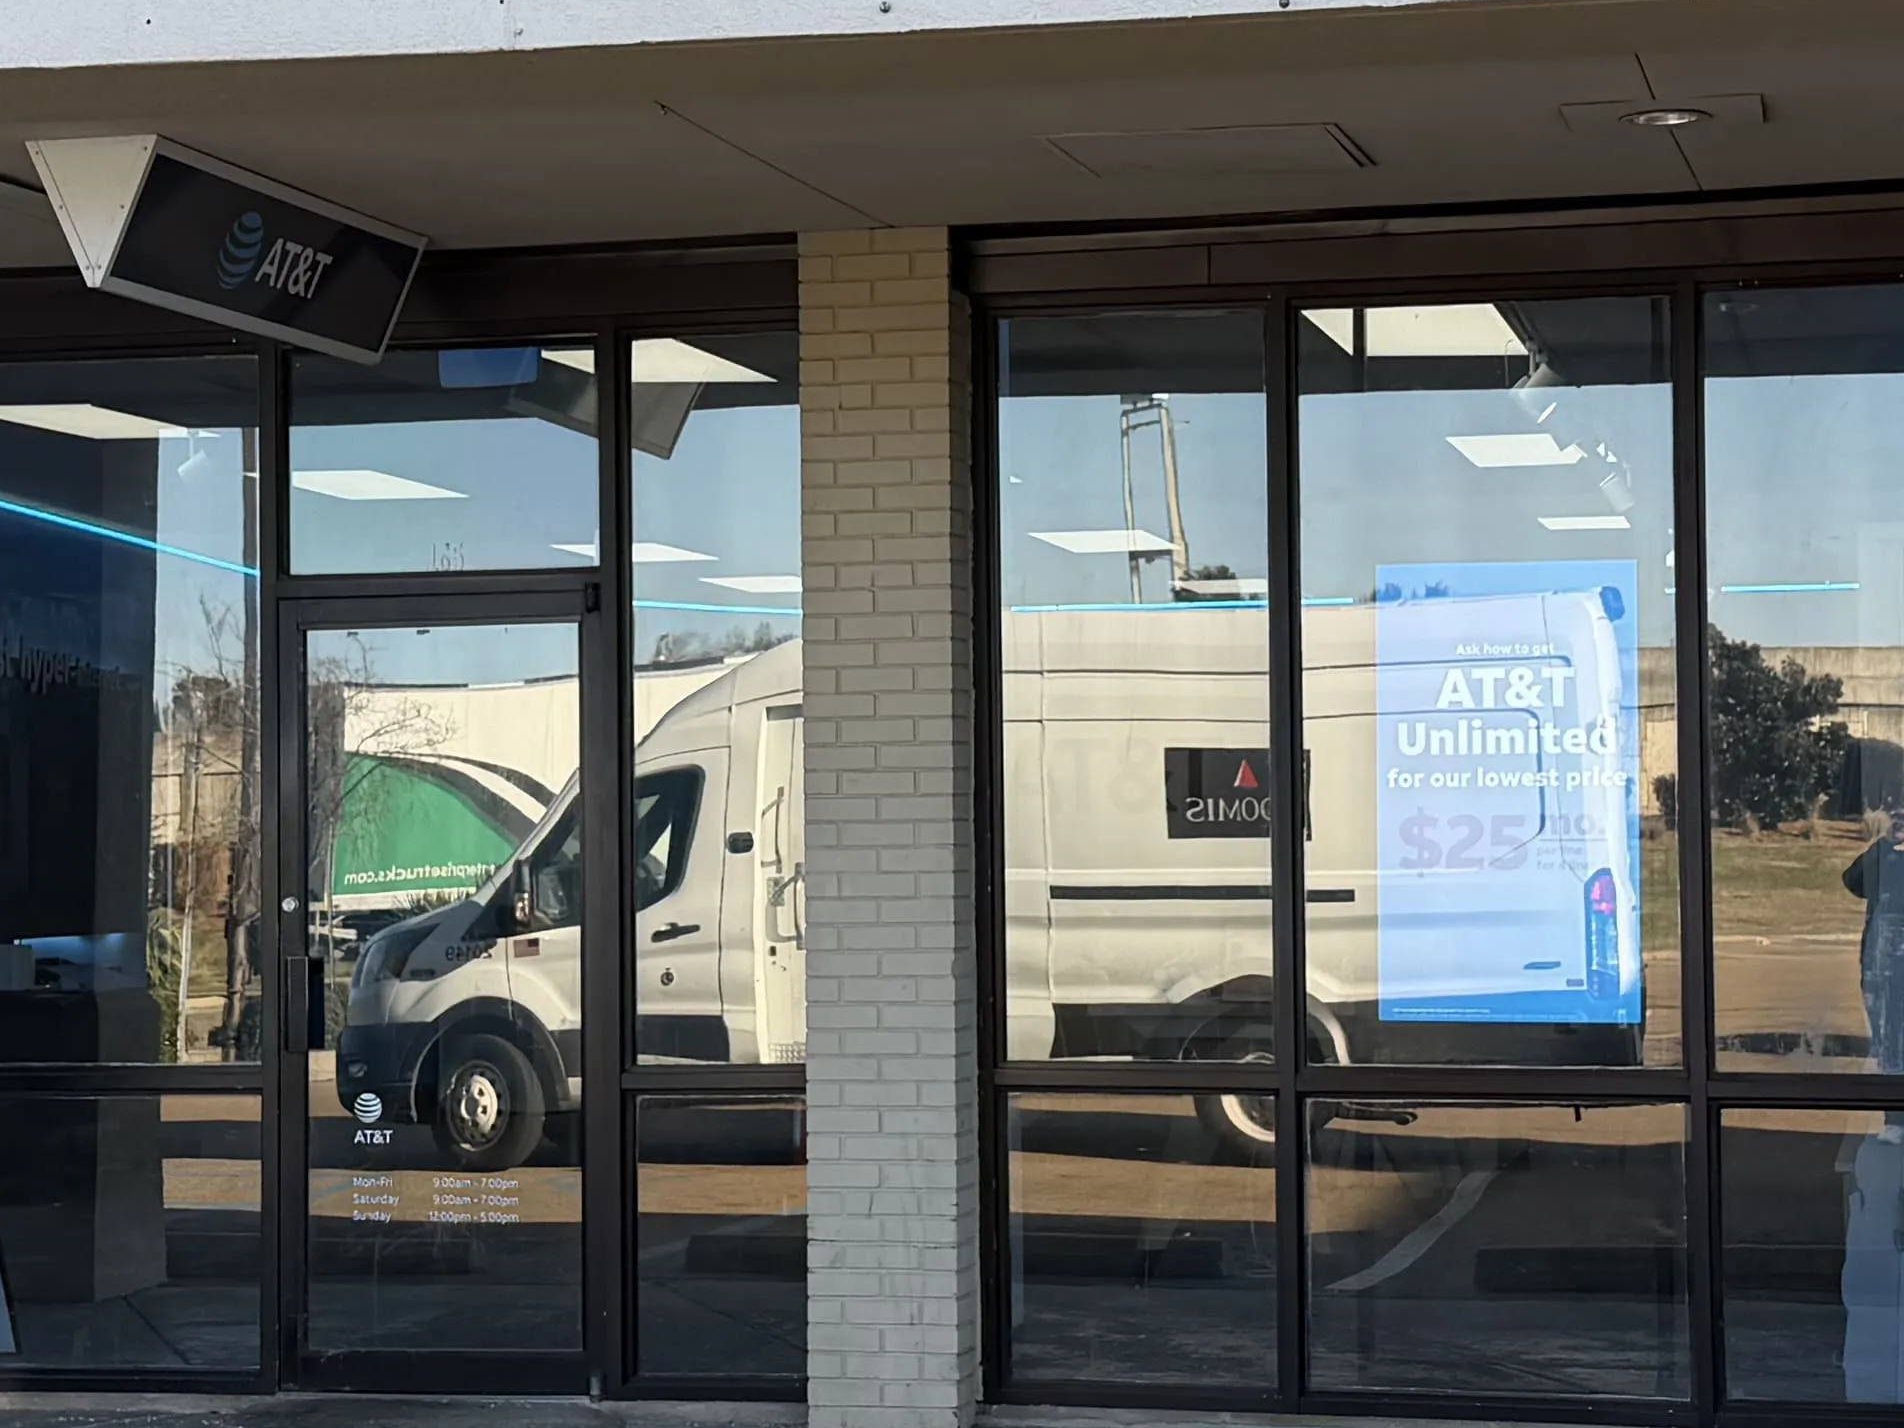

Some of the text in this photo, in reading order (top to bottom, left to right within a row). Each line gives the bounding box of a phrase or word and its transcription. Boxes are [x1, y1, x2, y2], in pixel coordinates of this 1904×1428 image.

[255, 237, 333, 300] AT&T
[1456, 642, 1555, 656] Ask how to get
[1435, 667, 1576, 710] AT&T
[1396, 718, 1618, 757] Unlimited
[1386, 767, 1629, 792] for our lowest price
[1398, 805, 1606, 878] $25 mo.
[353, 1129, 393, 1145] AT&T
[352, 1176, 393, 1188] Mon-Fri
[352, 1193, 400, 1206] Saturday
[352, 1210, 392, 1223] Sunday
